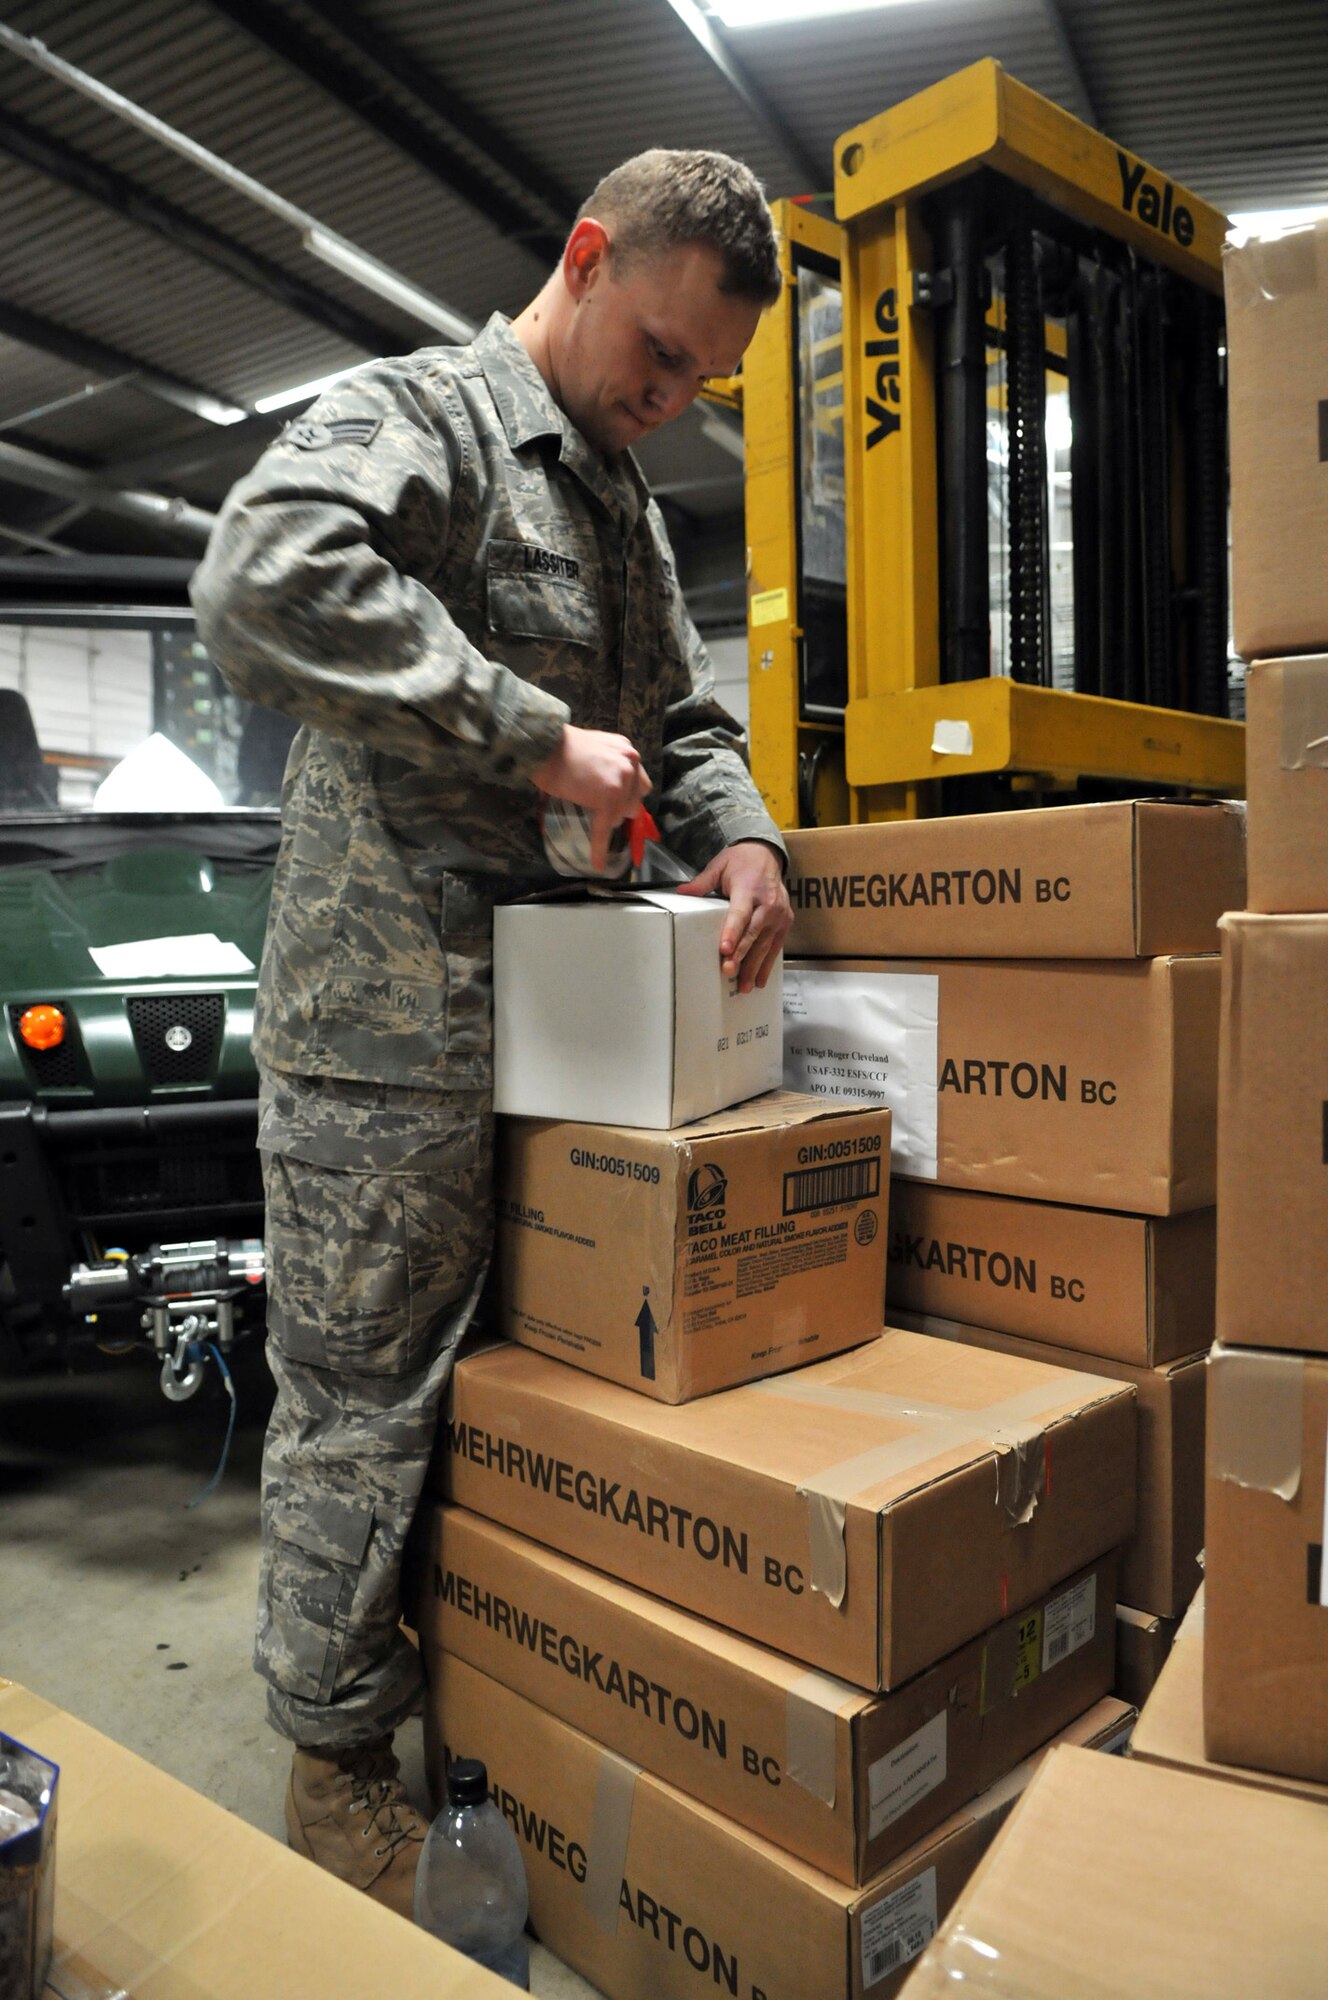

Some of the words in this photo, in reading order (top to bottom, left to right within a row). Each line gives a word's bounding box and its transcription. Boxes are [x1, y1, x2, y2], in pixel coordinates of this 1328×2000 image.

[1117, 151, 1195, 247] Yale
[864, 287, 902, 452] Yale
[524, 547, 580, 580] LASSITER
[785, 868, 1022, 909] HRWEGKARTON
[1035, 876, 1072, 904] BC
[789, 1047, 803, 1056] To:
[806, 1047, 826, 1060] MSgt
[827, 1049, 849, 1061] Roger
[851, 1051, 889, 1064] Cleveland
[807, 1065, 846, 1078] USAF-332
[847, 1069, 889, 1082] ESFS/CCF
[937, 1058, 1067, 1102] ARTON
[1080, 1079, 1118, 1106] BC
[810, 1083, 828, 1094] APO
[829, 1086, 842, 1095] AE
[842, 1086, 886, 1101] 09315-9997
[797, 1134, 882, 1165] GIN:0051509
[570, 1147, 661, 1185] GIN:0051509
[510, 1201, 545, 1223] FILLING
[686, 1208, 727, 1225] TACO
[687, 1220, 727, 1237] BELL
[719, 1246, 742, 1258] COLOR
[742, 1243, 756, 1253] AND
[756, 1238, 782, 1249] NATURAL
[783, 1231, 805, 1242] SMOKE
[805, 1226, 828, 1238] FLAVOR
[720, 1229, 752, 1248] MEAT
[754, 1220, 796, 1241] FILLING
[1050, 1275, 1086, 1303] BC
[446, 1421, 749, 1575] MEHRWEGKARTON
[764, 1556, 805, 1595] BC
[433, 1562, 727, 1760] MEHRWEGKARTON
[741, 1744, 782, 1786] BC
[444, 1745, 738, 1998] HRWEGARTON
